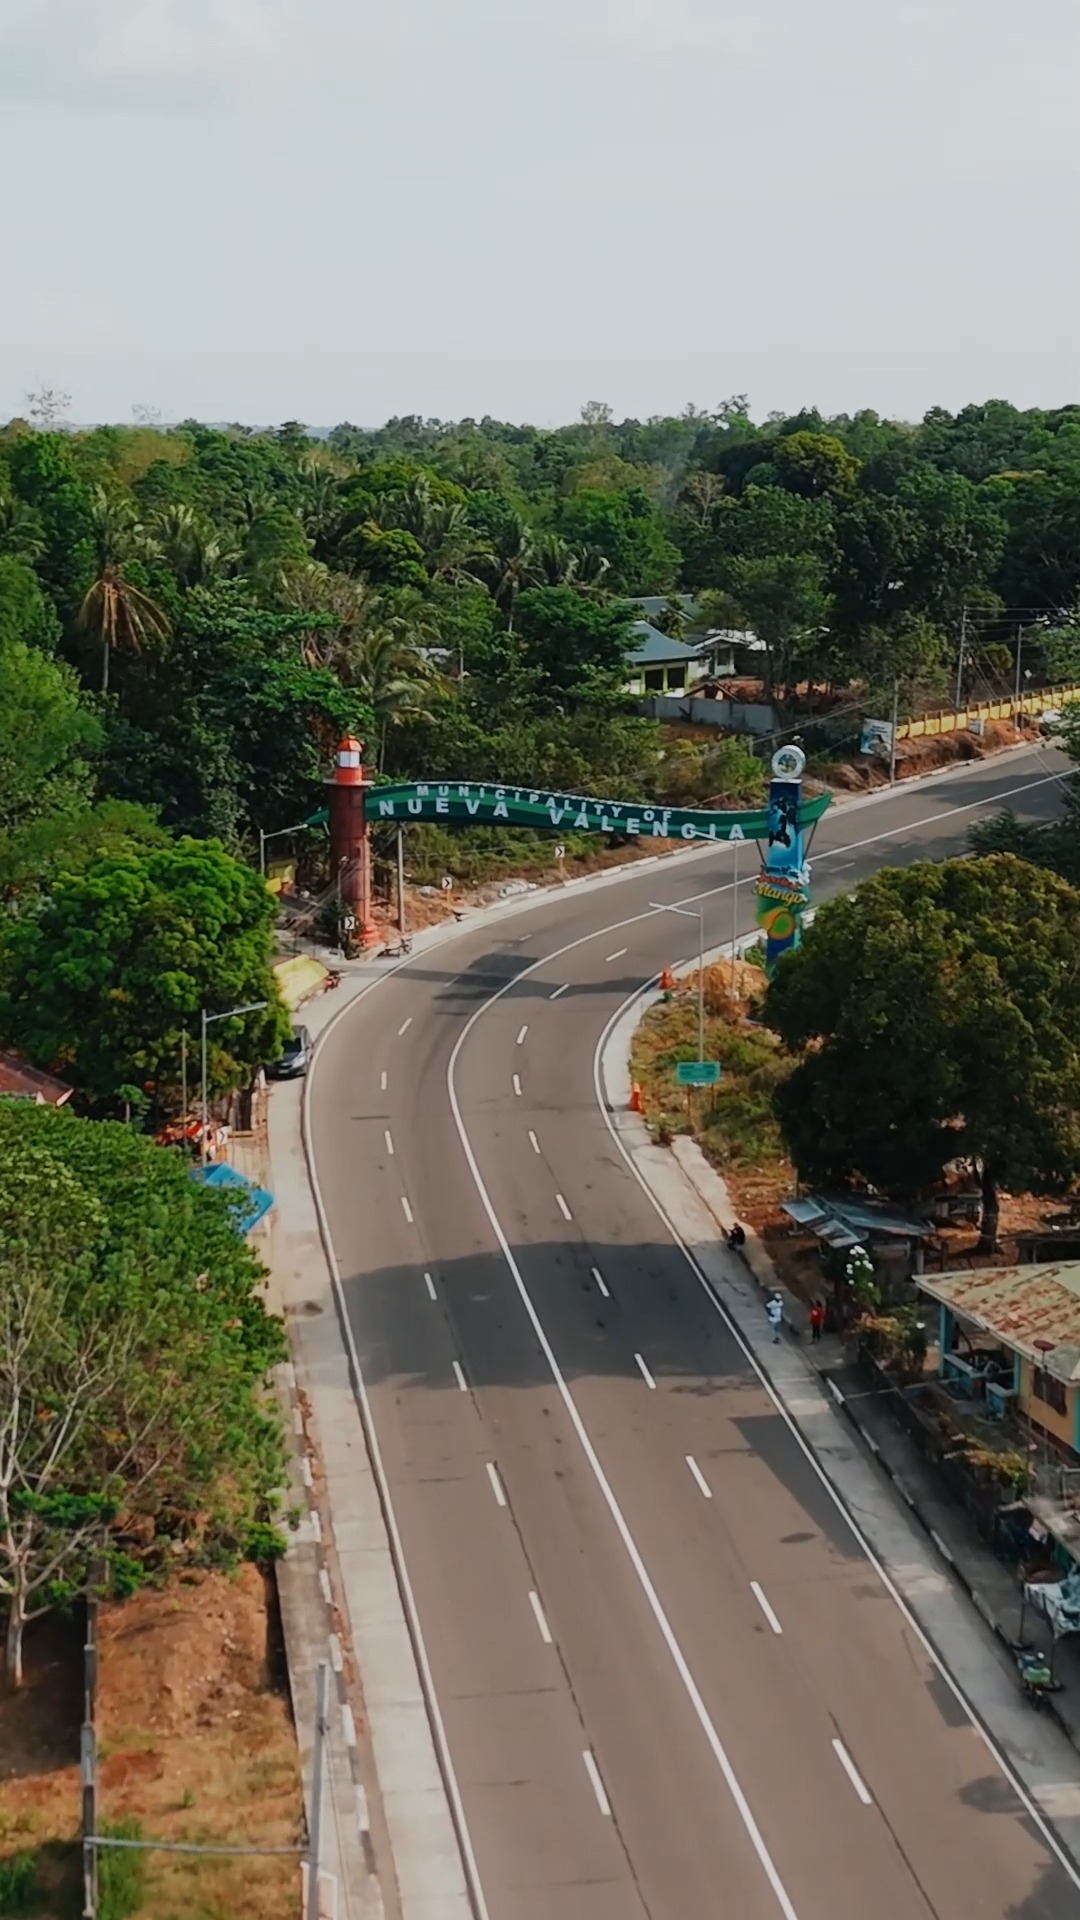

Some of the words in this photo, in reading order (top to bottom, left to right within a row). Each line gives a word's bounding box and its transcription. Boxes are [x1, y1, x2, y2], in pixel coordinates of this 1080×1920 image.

[379, 797, 509, 817] NUEVA
[416, 785, 622, 818] MUNICIPALITY
[643, 809, 673, 822] OF
